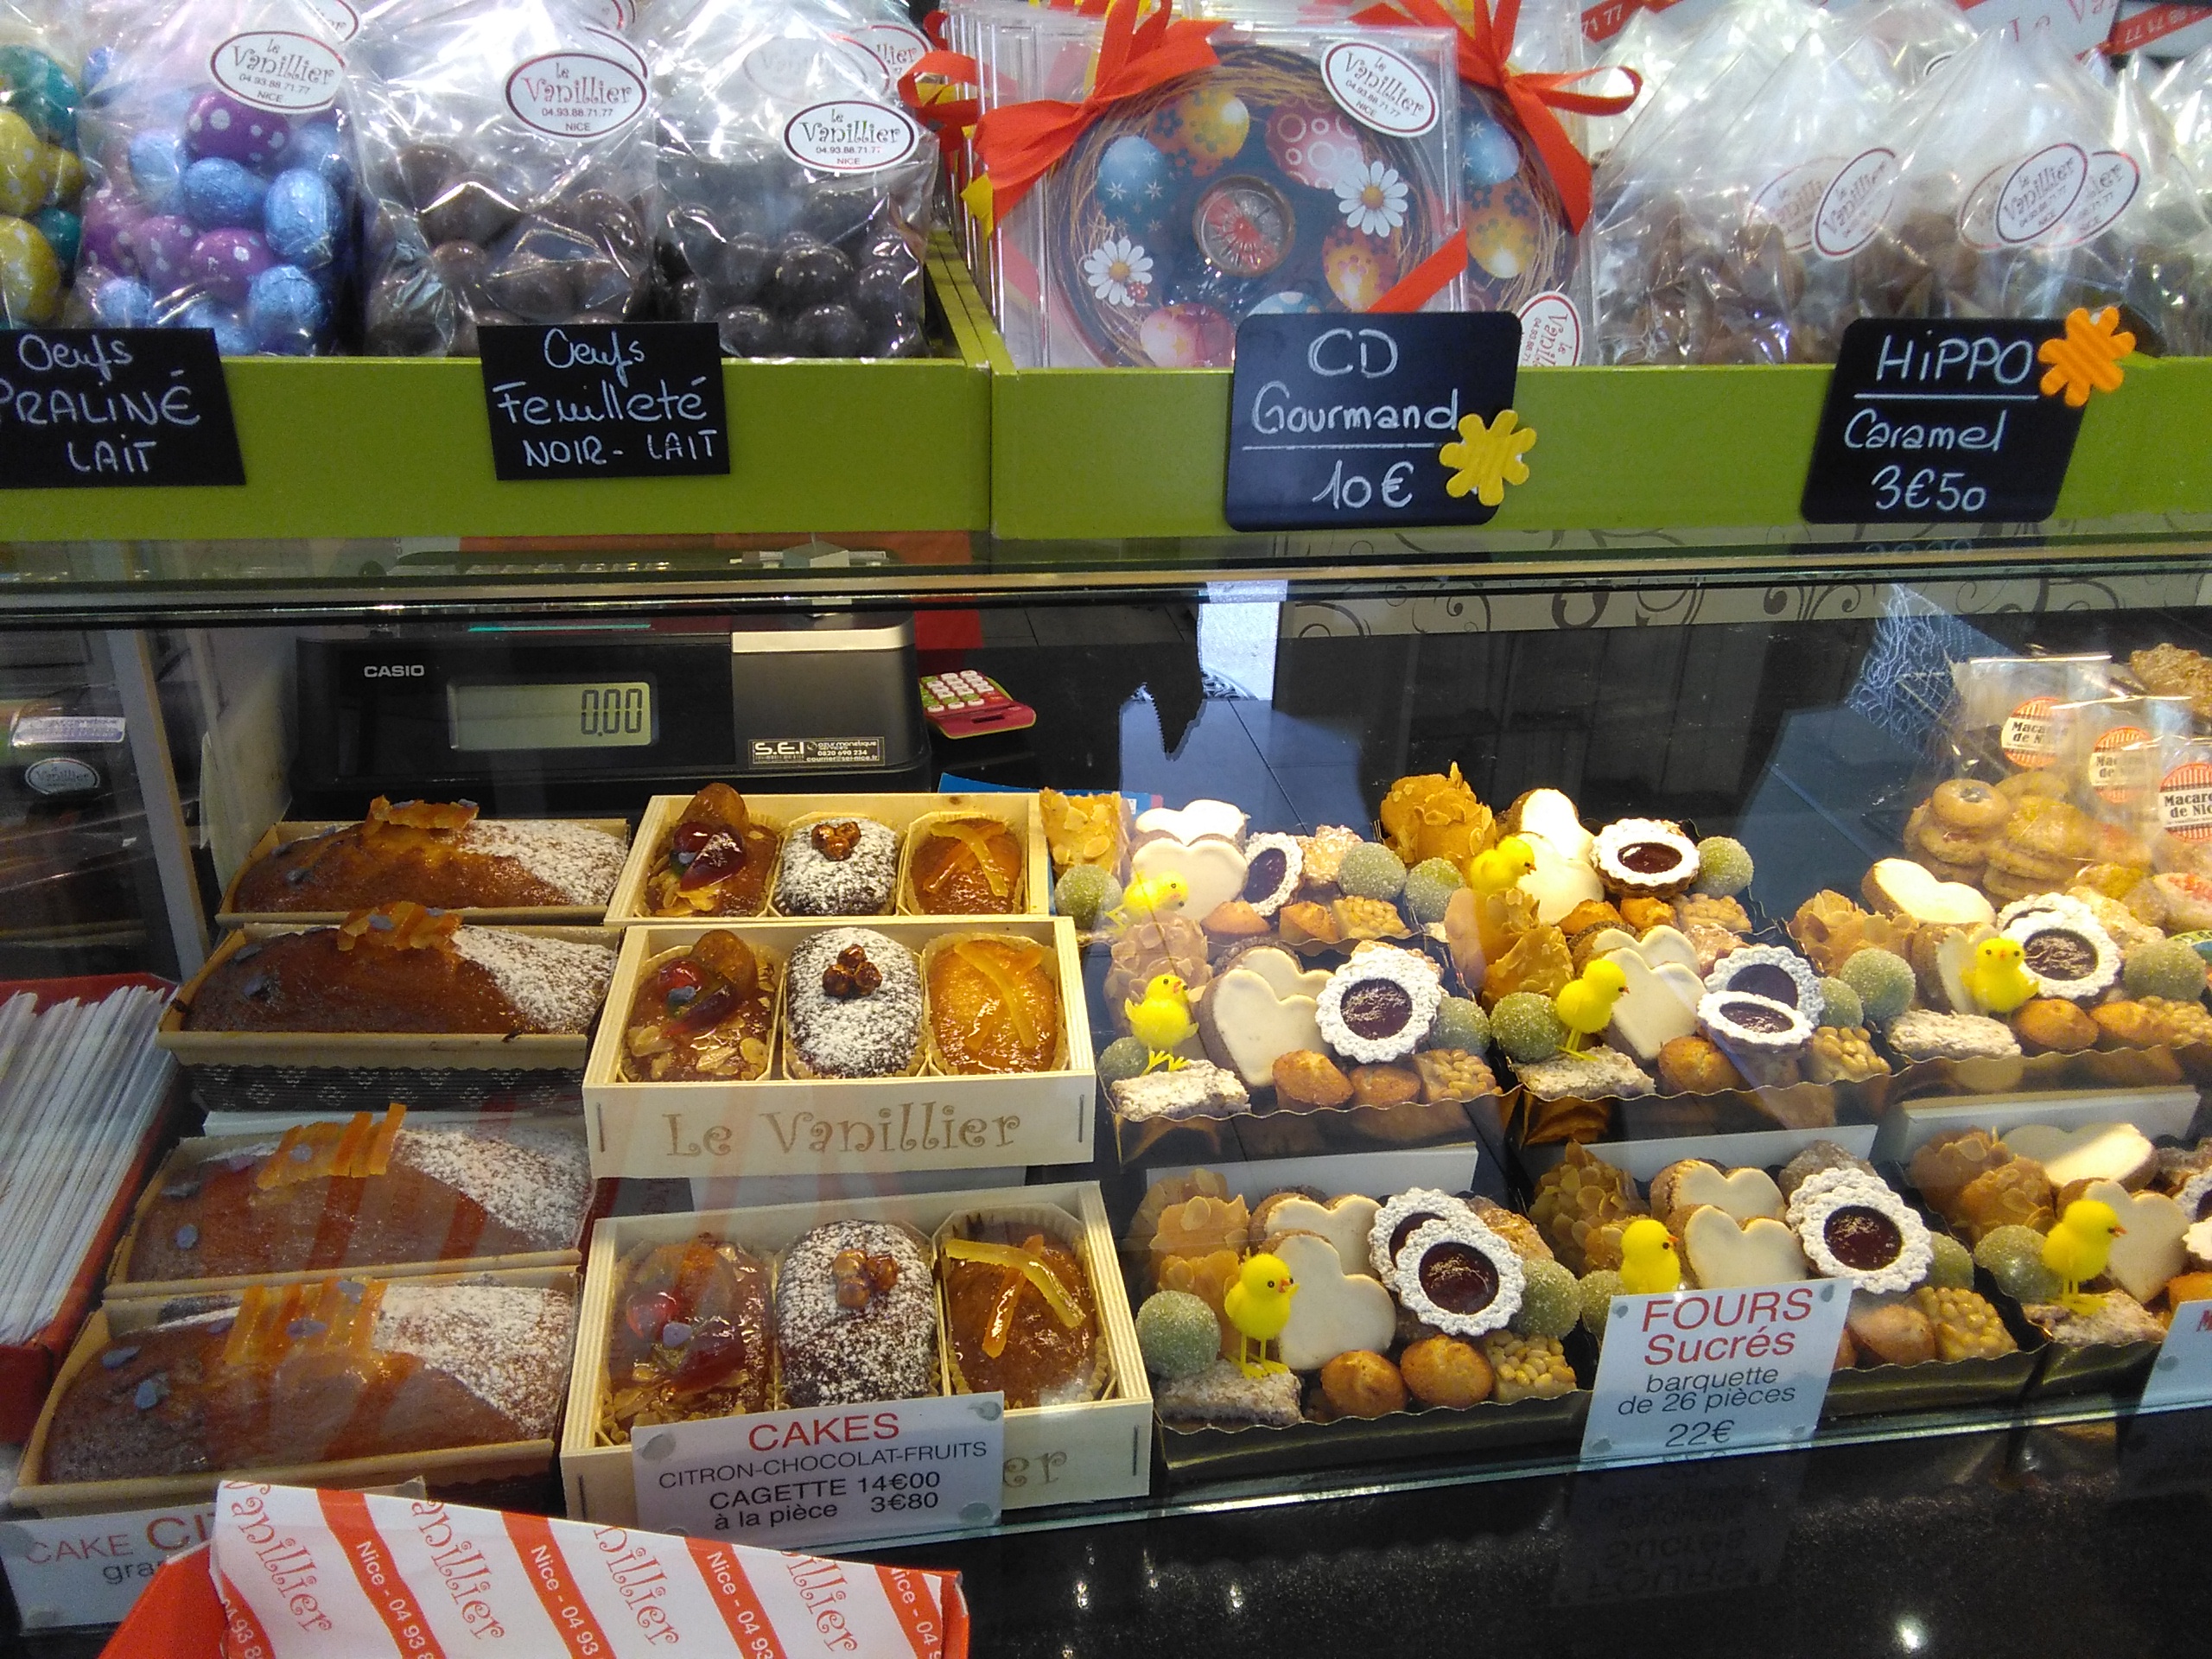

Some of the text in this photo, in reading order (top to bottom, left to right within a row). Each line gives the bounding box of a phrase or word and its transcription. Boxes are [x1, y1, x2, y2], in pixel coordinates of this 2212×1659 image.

[1604, 3, 1624, 26] 77
[233, 46, 335, 85] Vanillier
[1344, 51, 1424, 117] Vanillier
[257, 91, 283, 103] NICE
[520, 76, 632, 104] Vanillier
[1356, 100, 1377, 118] NICE
[565, 122, 590, 131] NICE
[799, 120, 901, 143] Vanillier
[2004, 157, 2075, 220] Vanillier
[1307, 327, 1398, 378] CD
[493, 376, 708, 426] Feuilleté
[1253, 380, 1459, 435] Gourmand
[647, 429, 717, 461] LAIT
[1844, 408, 2007, 452] Caramel
[1313, 460, 1414, 510] 10€
[1872, 464, 1986, 512] 3€50
[364, 664, 425, 677] CASIO
[581, 689, 643, 736] 0.00
[2170, 805, 2188, 818] de
[662, 1100, 1021, 1157] Le Vanillier
[1643, 1287, 1814, 1332] FOURS
[1644, 1325, 1796, 1366] Sucrés
[1618, 1385, 1796, 1415] de 26 pièces
[1646, 1366, 1779, 1394] barquette
[748, 1412, 900, 1453] CAKES
[1666, 1420, 1735, 1448] 22€
[658, 1441, 988, 1490] CITRON-CHOCOLAT-FRUITS
[709, 1471, 941, 1511] CAGETTE 14€00
[714, 1491, 938, 1531] à la pièce 3€80
[26, 1534, 134, 1564] CAKE
[411, 1500, 505, 1640] anillier
[356, 1541, 385, 1586] Nice
[389, 1599, 412, 1622] 04
[404, 1624, 426, 1649] 93
[531, 1544, 560, 1591] Nice
[562, 1605, 585, 1629] 04
[576, 1630, 600, 1656] 93
[707, 1551, 736, 1595] Nice
[738, 1611, 760, 1635] 04
[231, 1618, 254, 1643] 93
[916, 1621, 938, 1646] 04
